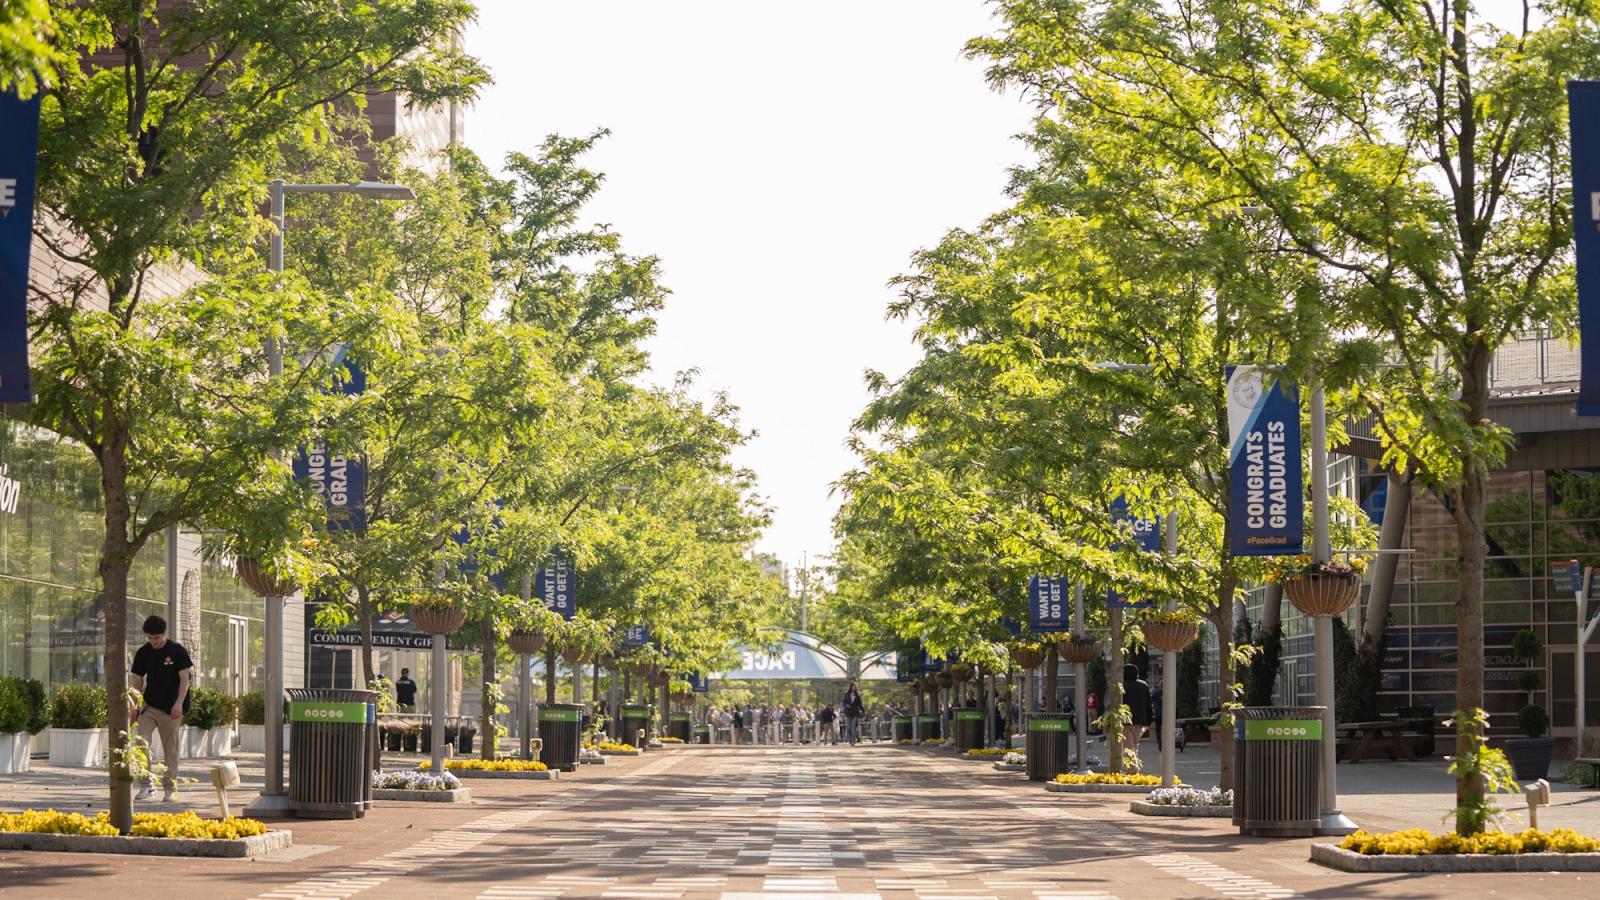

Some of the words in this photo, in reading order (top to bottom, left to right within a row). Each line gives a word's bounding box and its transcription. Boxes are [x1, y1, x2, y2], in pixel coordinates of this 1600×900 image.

[0, 462, 20, 514] ion
[330, 449, 348, 506] GRAD
[1245, 430, 1265, 529] CONGRATS
[1267, 420, 1287, 529] GRADUATES
[557, 594, 567, 609] GO
[1038, 590, 1049, 619] WANT
[1051, 583, 1061, 602] GET
[1051, 604, 1061, 619] GO
[313, 633, 413, 647] COMMENEMENT
